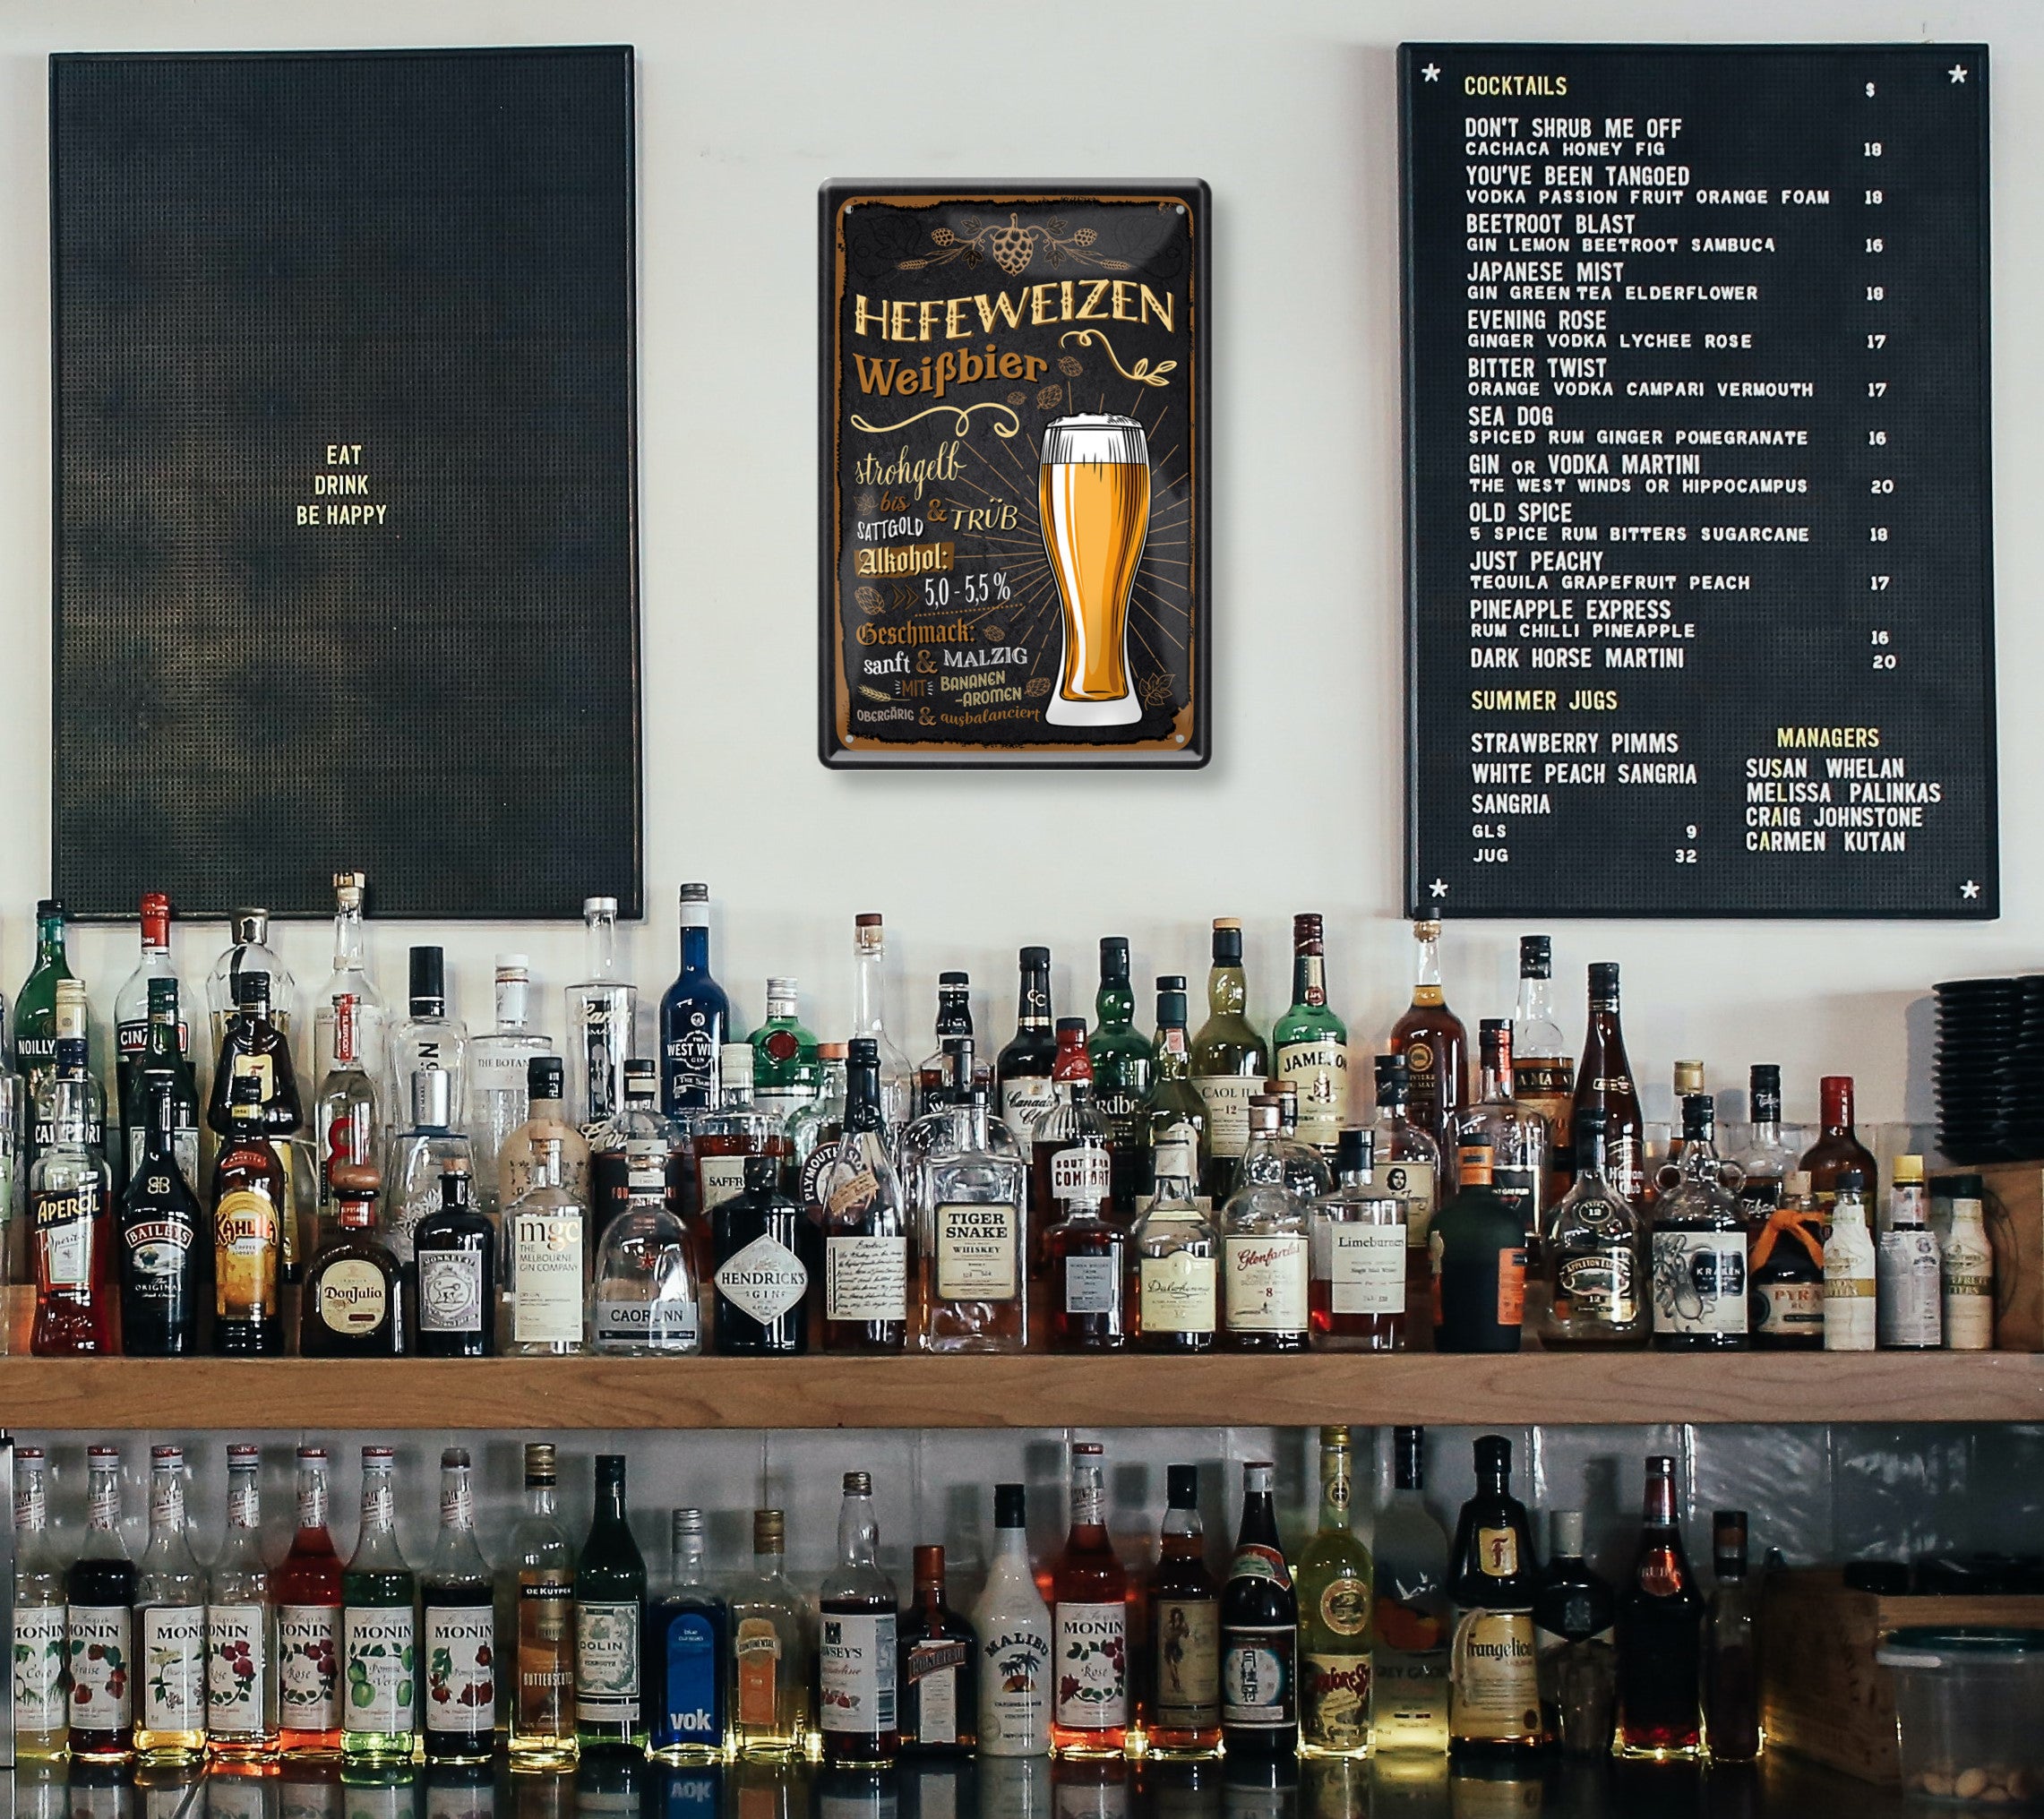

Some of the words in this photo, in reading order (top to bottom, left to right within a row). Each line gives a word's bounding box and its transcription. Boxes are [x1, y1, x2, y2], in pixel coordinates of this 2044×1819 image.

[1464, 75, 1567, 96] COCKTAILS
[1464, 116, 1519, 138] DON'T
[1532, 117, 1592, 139] SHRUB
[1604, 117, 1634, 139] ME
[1646, 117, 1682, 139] OFF
[1465, 141, 1550, 157] CACHACA
[1562, 142, 1623, 157] HONEY
[1636, 142, 1665, 157] FIG
[1864, 142, 1882, 158] 18
[1465, 164, 1532, 186] YOU'VE
[1544, 165, 1593, 186] BEEN
[1604, 165, 1690, 187] TANGOED
[1465, 189, 1526, 204] VODKA
[1539, 189, 1618, 204] PASSION
[1630, 189, 1684, 205] FRUIT
[1696, 189, 1768, 205] ORANGE
[1782, 189, 1830, 205] FOAM
[1865, 190, 1883, 205] 18
[1466, 213, 1563, 235] BEETROOT
[1576, 213, 1636, 235] BLAST
[1466, 237, 1497, 253] GIN
[1509, 237, 1570, 253] LEMON
[1582, 237, 1679, 253] BEETROOT
[1691, 237, 1775, 253] SAMBUCA
[1865, 238, 1884, 253] 16
[1466, 261, 1564, 282] JAPANESE
[1576, 262, 1624, 283] MIST
[1467, 285, 1498, 300] GIN
[1509, 285, 1571, 301] GREEN
[1576, 286, 1612, 301] TEA
[1625, 285, 1758, 301] ELDERFLOWER
[1866, 286, 1884, 301] 18
[855, 279, 1174, 342] HEFEWEIZEN
[1467, 309, 1546, 330] EVENING
[1559, 309, 1607, 331] ROSE
[1467, 333, 1534, 348] GINGER
[1546, 333, 1607, 348] VODKA
[1619, 333, 1692, 348] LYCHEE
[1705, 333, 1752, 349] ROSE
[1867, 334, 1886, 349] 17
[853, 344, 1048, 398] Weißbier
[1468, 406, 1505, 426] SEA
[1516, 406, 1554, 426] DOG
[1469, 429, 1536, 445] SPICED
[1548, 430, 1585, 445] RUM
[1596, 429, 1663, 445] GINGER
[1675, 430, 1808, 446] POMEGRANATE
[1868, 430, 1886, 446] 16
[327, 444, 362, 466] EAT
[1469, 453, 1499, 475] GIN
[1511, 459, 1536, 476] OR
[1547, 453, 1610, 475] VODKA
[1621, 453, 1700, 476] MARTINI
[855, 441, 966, 500] strohgelb
[314, 474, 369, 496] DRINK
[1469, 477, 1505, 493] THE
[1516, 477, 1567, 493] WEST
[1576, 477, 1631, 493] WINDS
[1645, 478, 1670, 493] OR
[1682, 478, 1808, 494] HIPPOCAMPUS
[1870, 479, 1894, 494] 20
[880, 491, 911, 512] bis
[1469, 502, 1506, 523] OLD
[1517, 502, 1572, 523] SPICE
[296, 504, 321, 526] BE
[327, 504, 387, 526] HAPPY
[926, 498, 949, 522] &
[951, 499, 1018, 531] TRÜB
[857, 517, 924, 541] SATTGOLD
[1469, 526, 1481, 541] 5
[1494, 526, 1548, 542] SPICE
[1561, 526, 1598, 542] RUM
[1610, 526, 1687, 542] BITTERS
[1701, 527, 1809, 543] SUGARCANE
[1870, 527, 1888, 542] 18
[858, 542, 949, 576] Alkohol:
[924, 576, 949, 609] 5,0
[965, 573, 990, 605] 5,5
[993, 571, 1011, 601] %
[855, 618, 975, 648] Geschmack:
[863, 651, 911, 675] sanft
[915, 649, 938, 674] &
[943, 647, 1028, 668] MALZIG
[901, 680, 928, 698] MIT
[940, 670, 1006, 692] BANANEN
[1471, 690, 1557, 711] SUMMER
[1568, 690, 1618, 710] JUGS
[856, 707, 915, 723] OBERGÄRIG
[918, 707, 937, 726] &
[940, 705, 1041, 727] ausbalanciert
[1471, 732, 1599, 754] STRAWBERRY
[1611, 733, 1679, 754] PIMMS
[1777, 727, 1880, 749] MANAGERS
[1472, 762, 1533, 785] WHITE
[1544, 762, 1606, 785] PEACH
[1618, 763, 1697, 785] SANGRIA
[1746, 757, 1808, 779] SUSAN
[1825, 758, 1904, 779] WHELAN
[1472, 793, 1551, 815] SANGRIA
[1747, 782, 1832, 803] MELISSA
[1850, 782, 1942, 804] PALINKAS
[1746, 806, 1801, 828] CRAIG
[1813, 806, 1923, 828] JOHNSTONE
[1472, 824, 1507, 838] GLS
[1686, 824, 1697, 839] 9
[1746, 830, 1826, 852] CARMEN
[1844, 830, 1905, 853] KUTAN
[1473, 847, 1508, 862] JUG
[1675, 848, 1697, 863] 32
[18, 1039, 56, 1055] NOILLY
[667, 1043, 693, 1057] WEST
[496, 1059, 530, 1068] BOTAN
[1201, 1086, 1237, 1098] CAOL
[709, 1176, 743, 1187] SAFFR
[38, 1193, 100, 1224] APEROL
[949, 1213, 1005, 1225] TIGER
[214, 1213, 277, 1246] KAHLA
[946, 1227, 1008, 1239] SNAKE
[520, 1244, 535, 1252] THE
[520, 1254, 572, 1263] MELBOURNE
[952, 1246, 1001, 1254] WHISKEY
[722, 1271, 806, 1285] HENDRICK'S
[611, 1308, 683, 1323] CAORNN
[1064, 1621, 1123, 1635] MONIN
[985, 1632, 1050, 1657] MALIBU
[671, 1709, 712, 1731] vok
